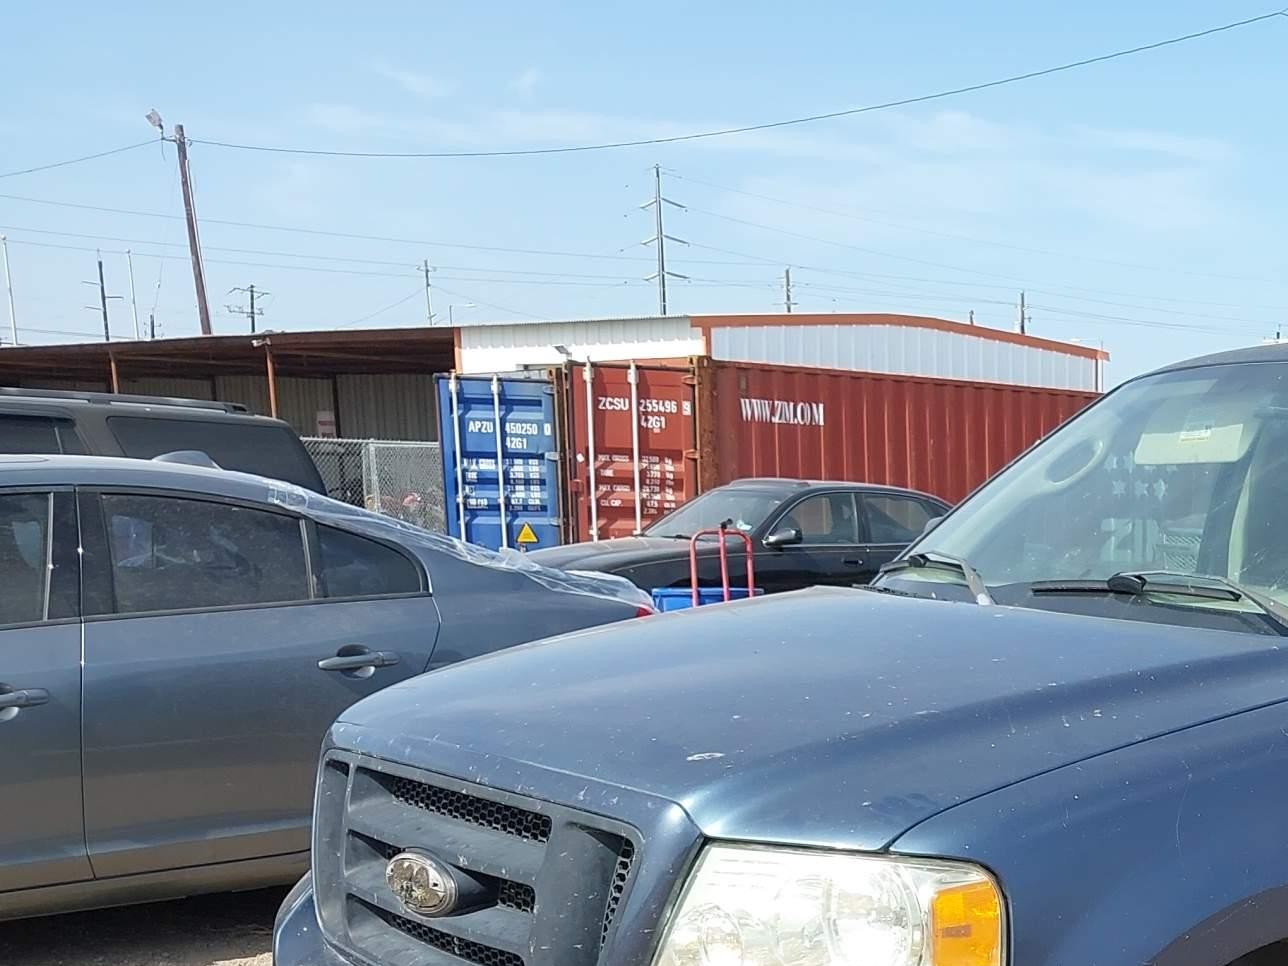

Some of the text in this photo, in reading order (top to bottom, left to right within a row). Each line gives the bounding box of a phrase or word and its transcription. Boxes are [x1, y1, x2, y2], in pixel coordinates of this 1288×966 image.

[598, 397, 629, 410] ZCSU
[639, 399, 677, 413] 255496
[468, 421, 494, 433] APZU
[504, 422, 538, 435] 450250
[641, 416, 665, 429] 42G1
[505, 437, 528, 449] 42G1
